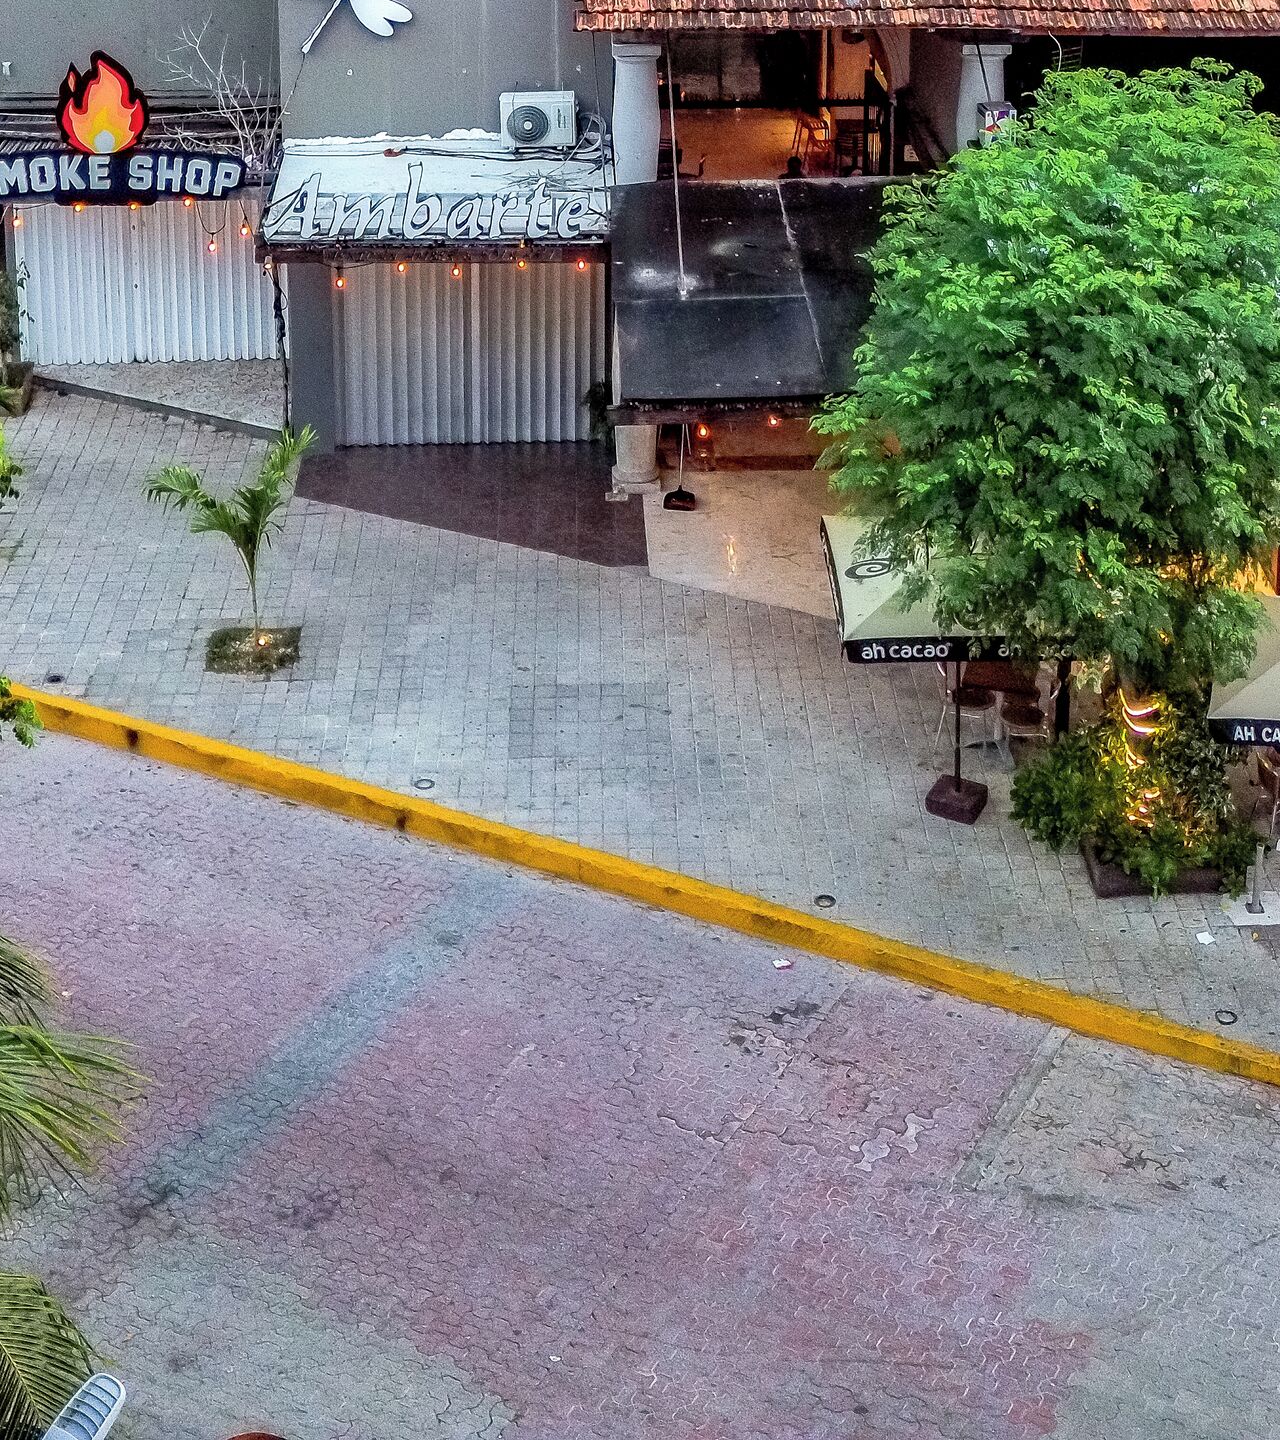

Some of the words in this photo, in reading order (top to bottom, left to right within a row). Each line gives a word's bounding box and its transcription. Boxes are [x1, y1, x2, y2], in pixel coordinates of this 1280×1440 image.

[127, 153, 243, 197] SHOP
[263, 160, 592, 240] Ambarte
[861, 642, 886, 660] ah
[888, 643, 950, 659] cacao
[1233, 724, 1256, 742] AH
